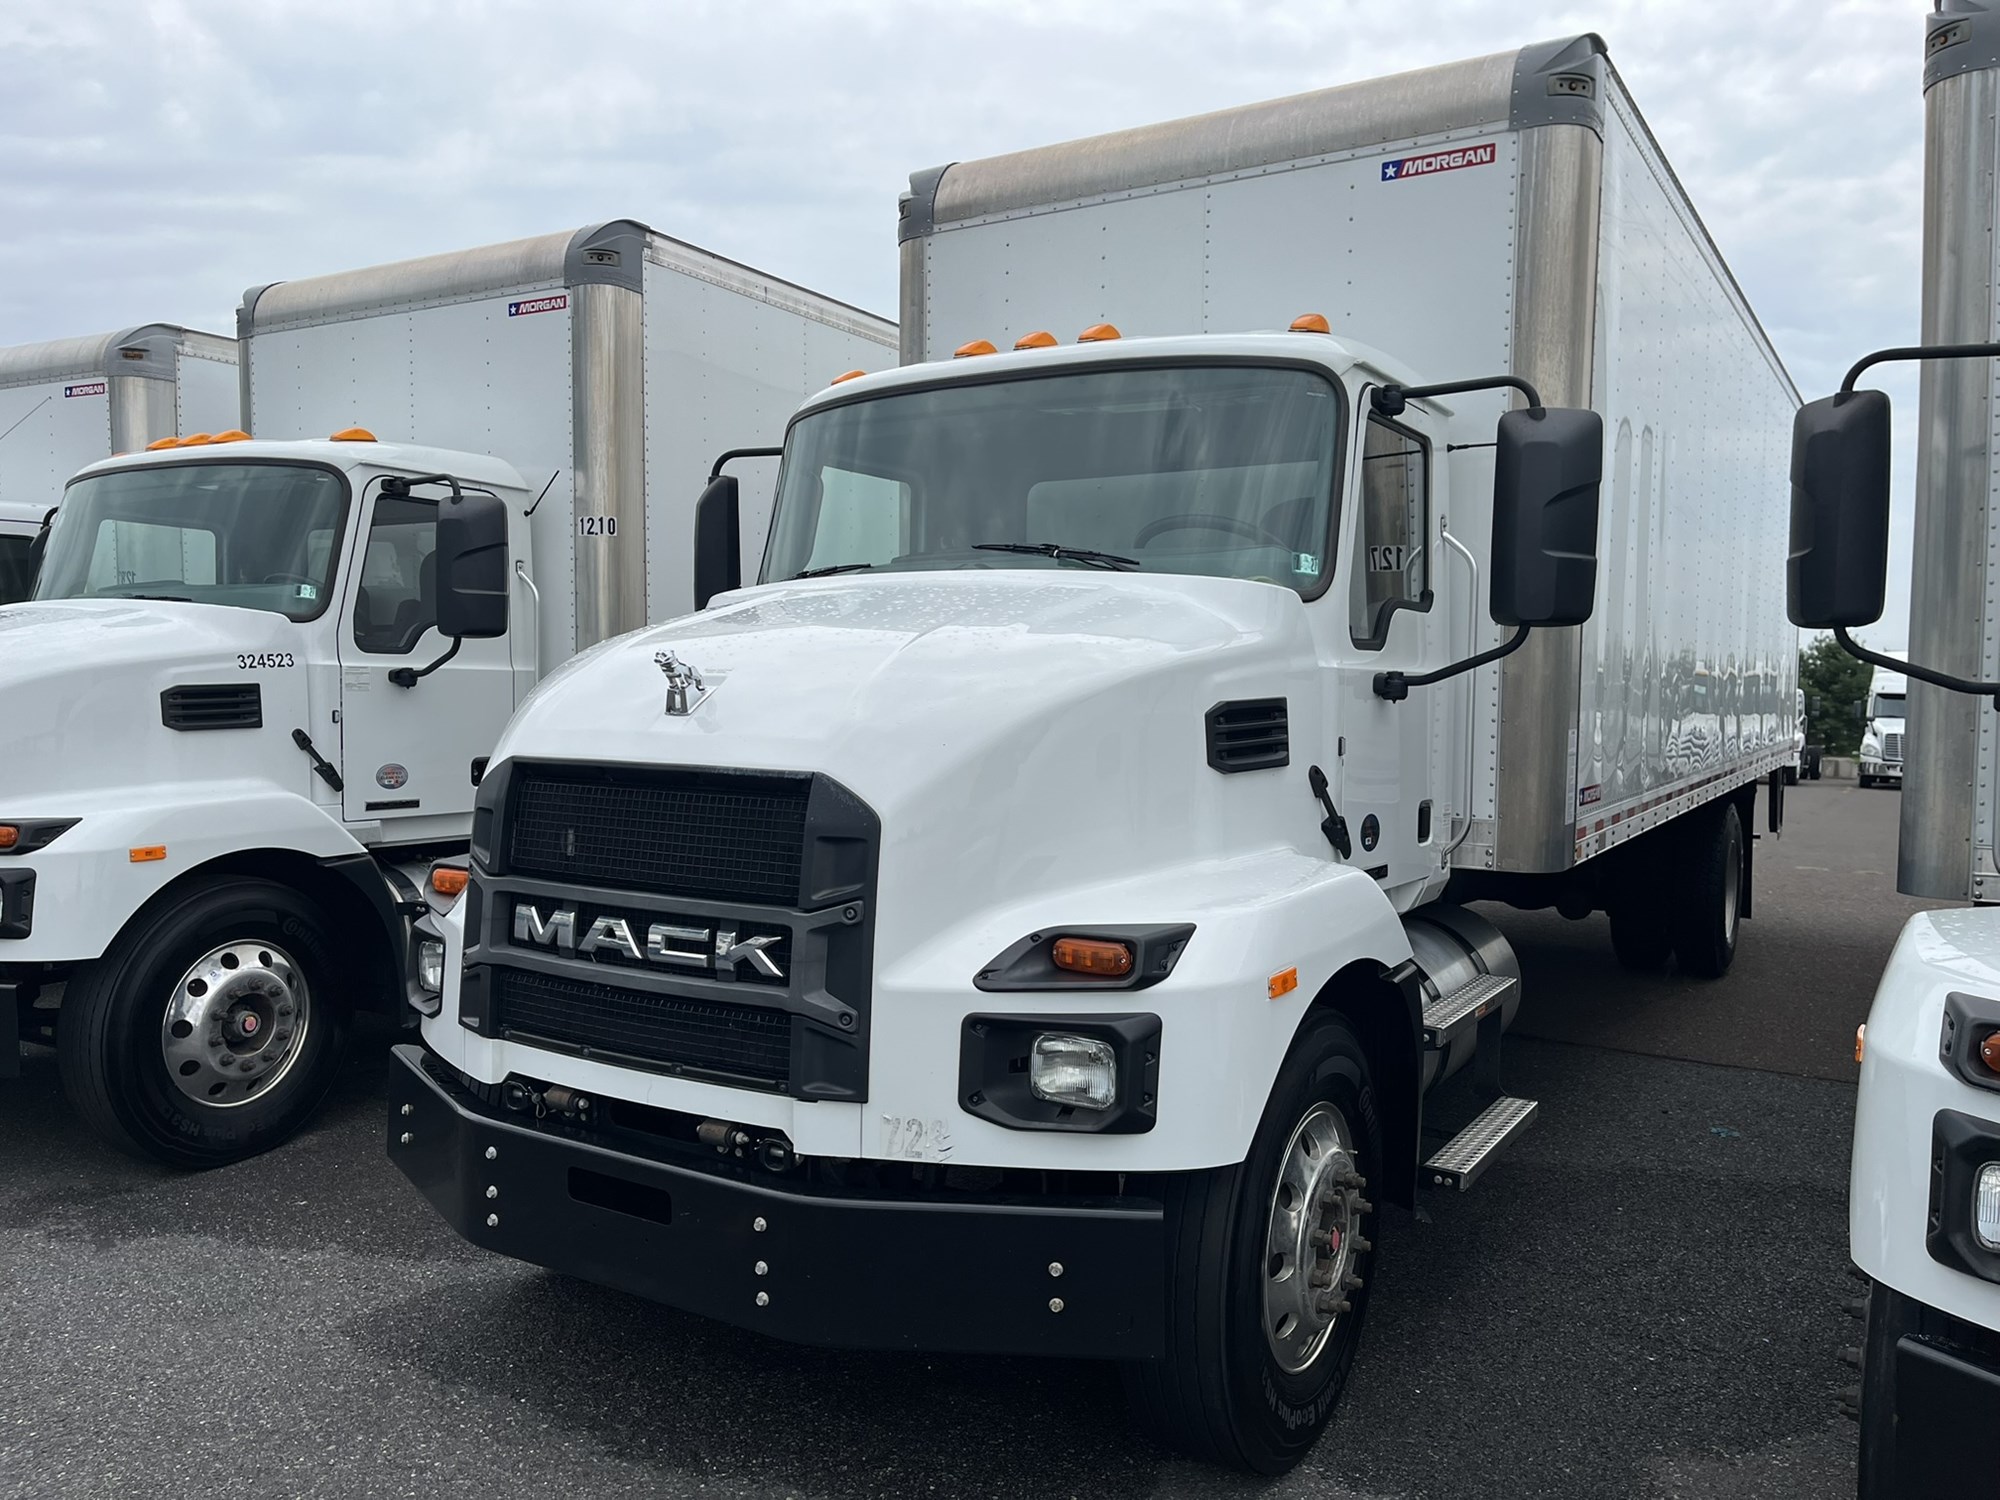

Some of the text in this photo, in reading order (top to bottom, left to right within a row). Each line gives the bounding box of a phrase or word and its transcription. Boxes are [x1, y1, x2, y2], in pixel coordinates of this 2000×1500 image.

[1401, 147, 1492, 176] MORGAN
[518, 297, 565, 314] MORGAN
[71, 384, 104, 397] MORGAN
[237, 652, 295, 670] 324523
[514, 903, 784, 978] MACK
